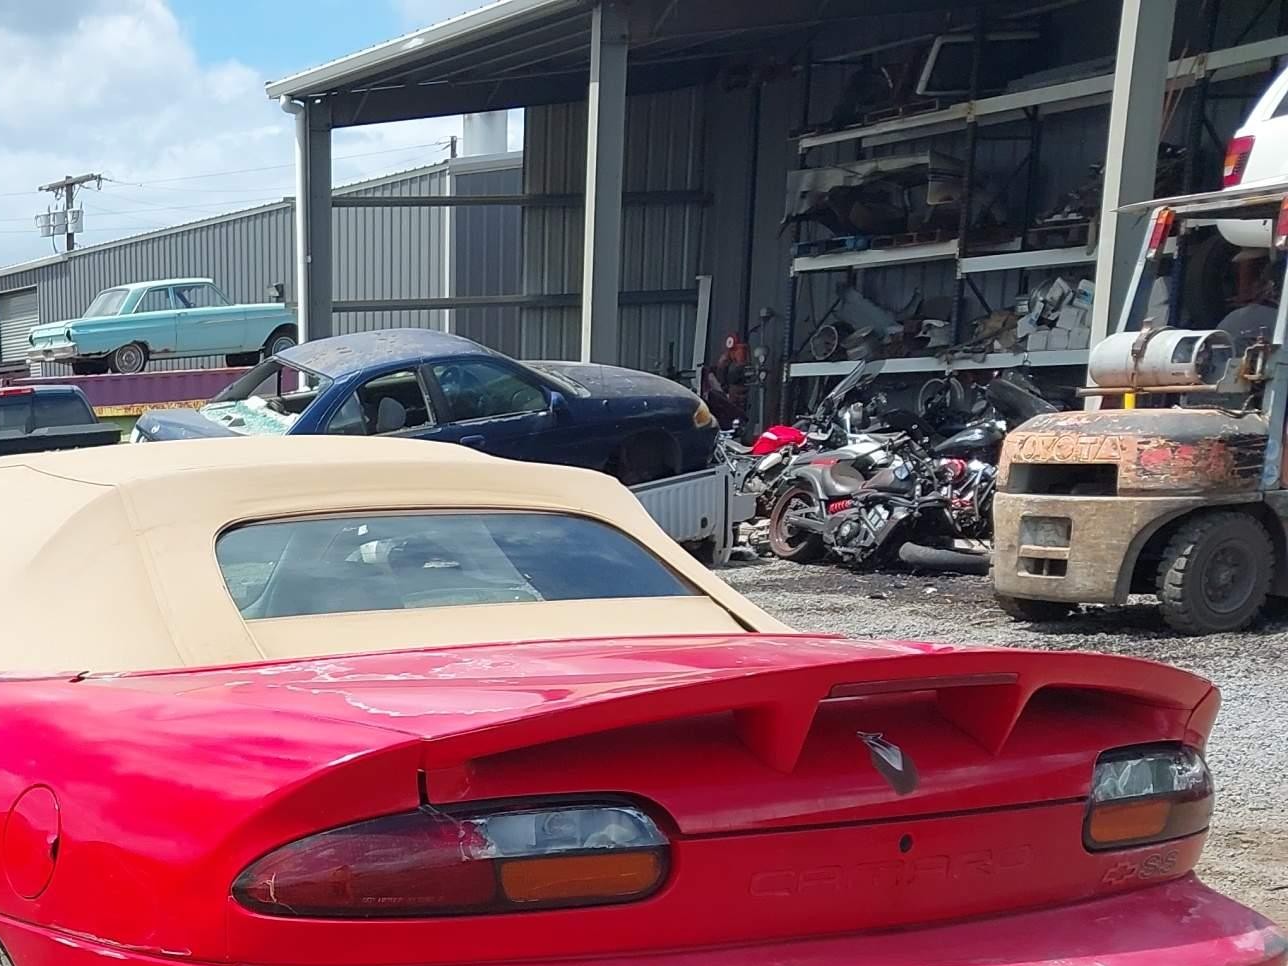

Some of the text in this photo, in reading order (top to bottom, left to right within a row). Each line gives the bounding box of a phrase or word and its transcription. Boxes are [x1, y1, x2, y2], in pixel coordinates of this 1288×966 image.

[1009, 434, 1124, 463] TOYOTA
[749, 843, 1033, 897] CAMARO
[1139, 849, 1179, 880] SS
